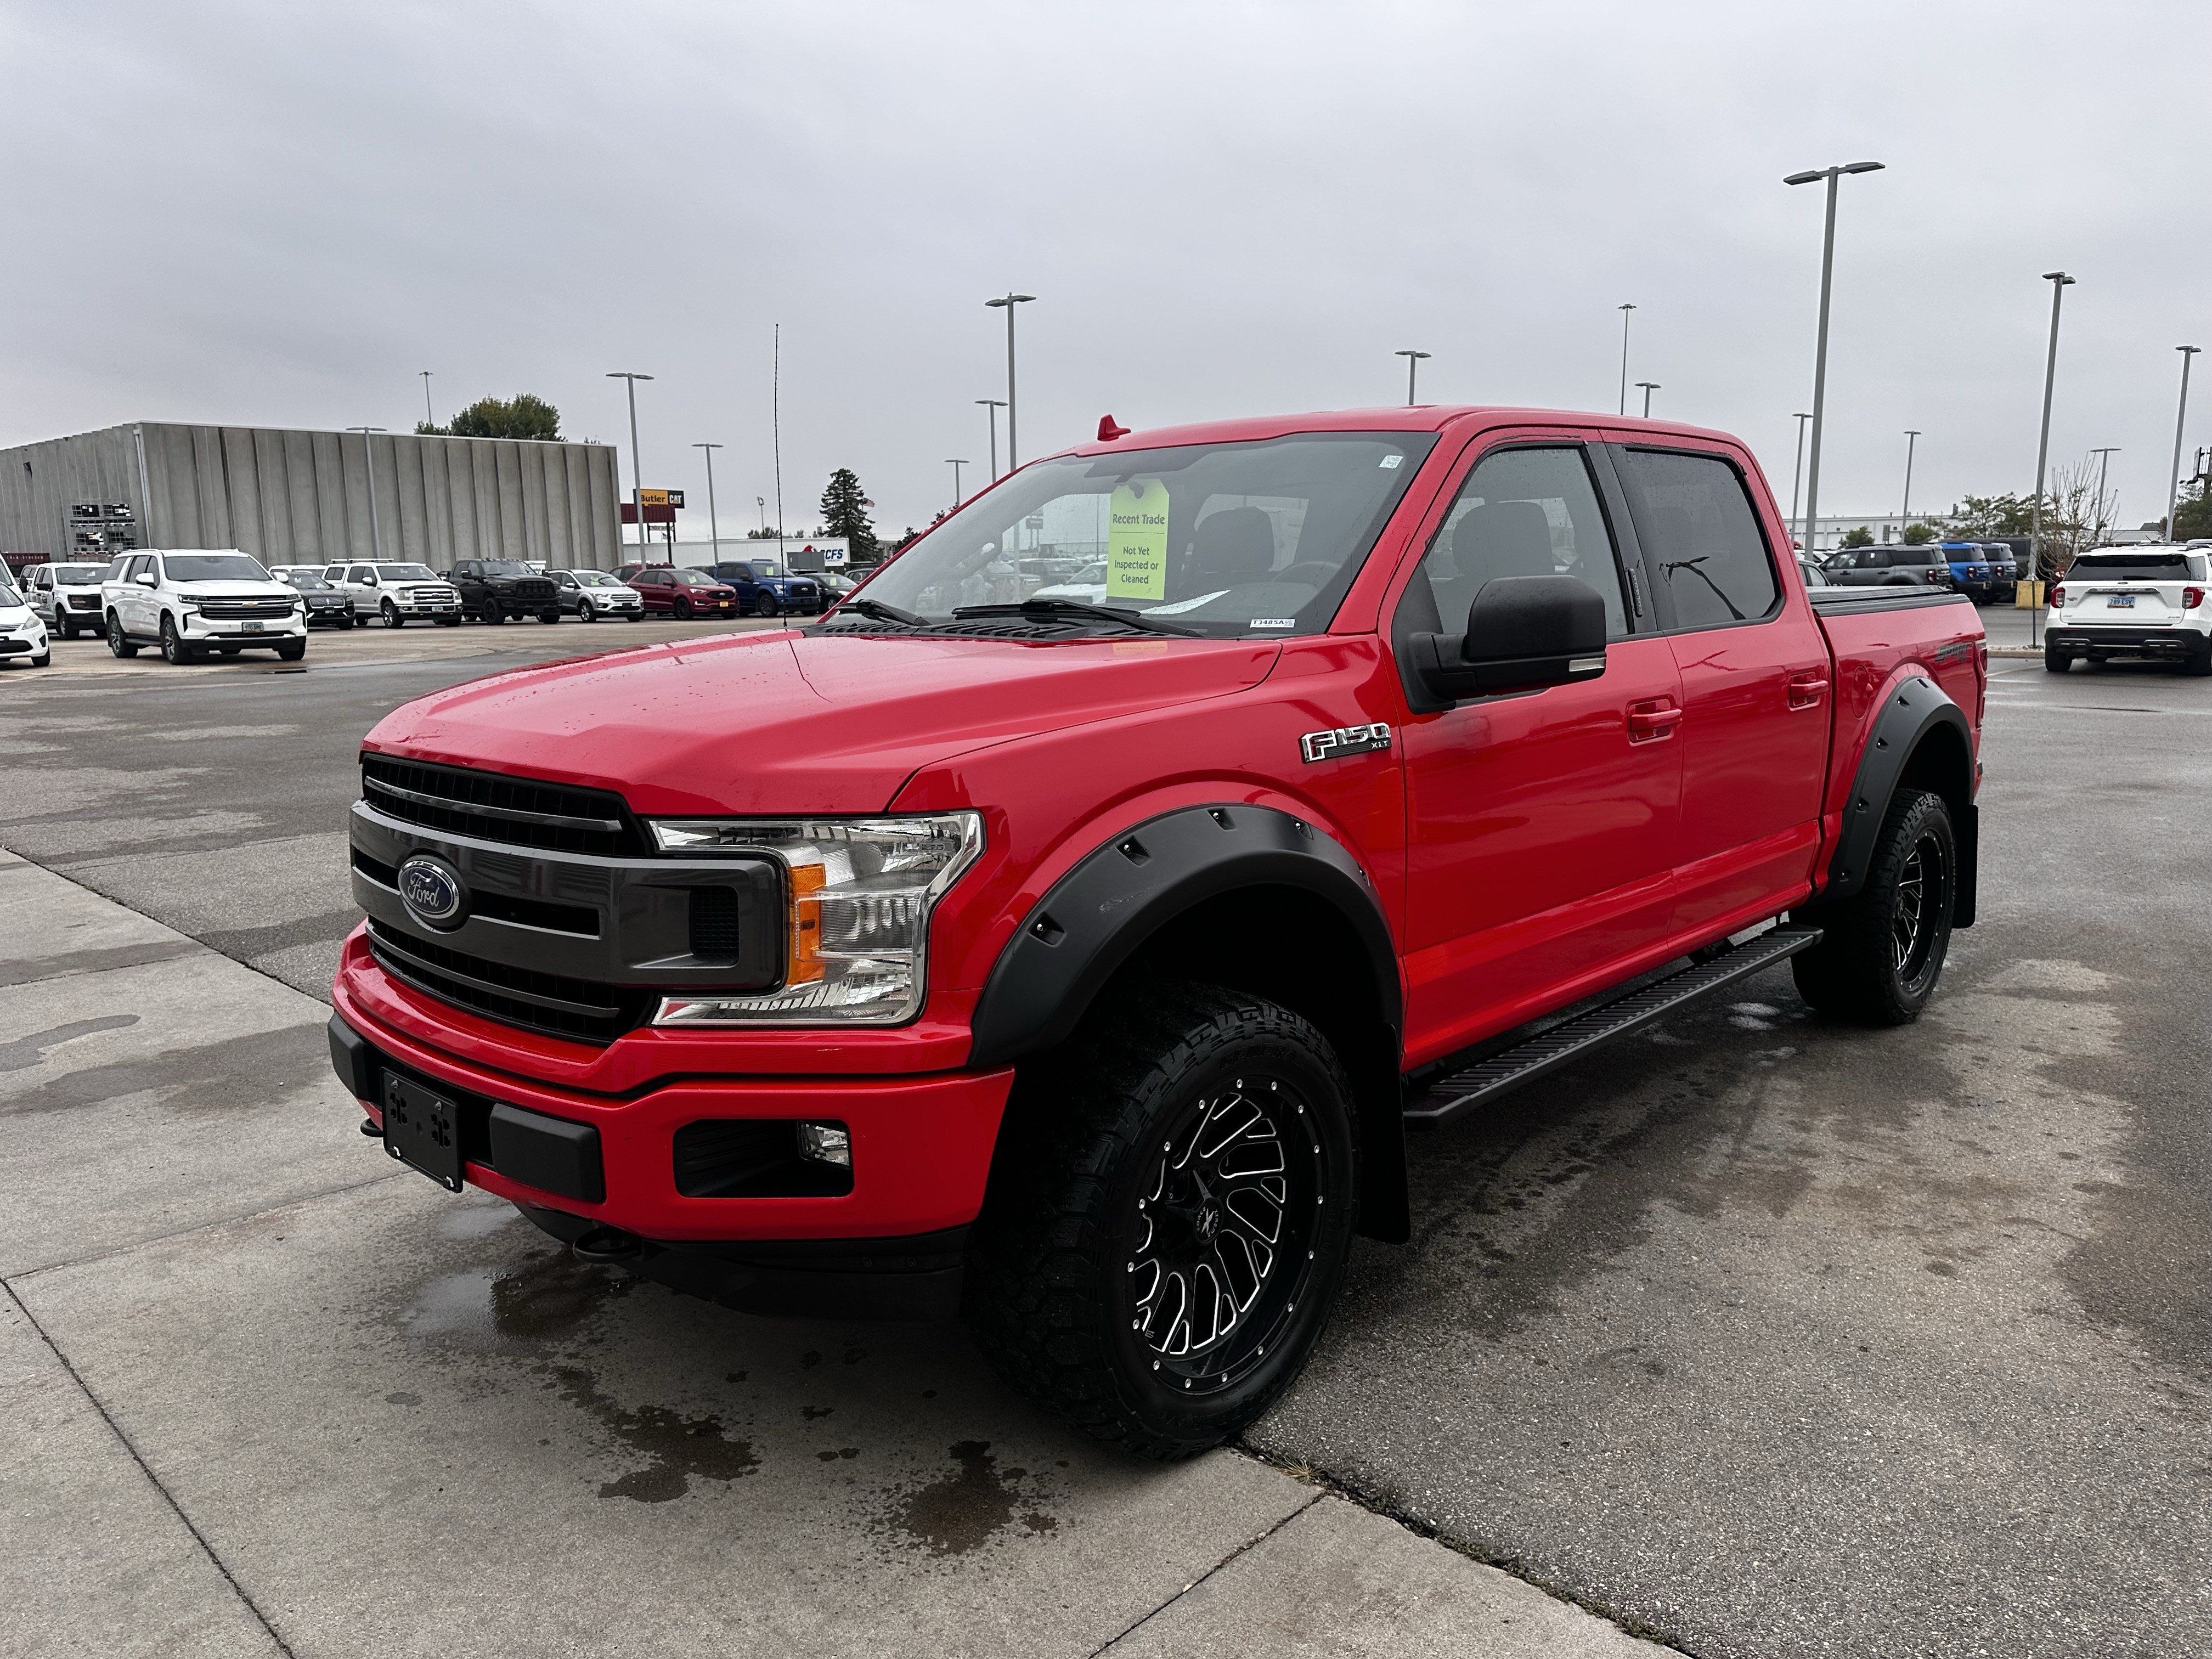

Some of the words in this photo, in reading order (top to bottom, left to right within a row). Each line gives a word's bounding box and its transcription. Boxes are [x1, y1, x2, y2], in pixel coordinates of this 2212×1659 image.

[640, 495, 665, 503] Butler
[669, 495, 682, 504] CAT
[1113, 514, 1139, 524] Recent
[1142, 514, 1165, 524] Trade
[820, 549, 844, 560] CFS
[1123, 546, 1136, 555] Not
[1138, 546, 1149, 556] Yet
[1114, 560, 1148, 570] Inspected
[1121, 574, 1149, 584] Cleaned
[1371, 741, 1390, 749] XLT
[407, 872, 441, 907] Ford
